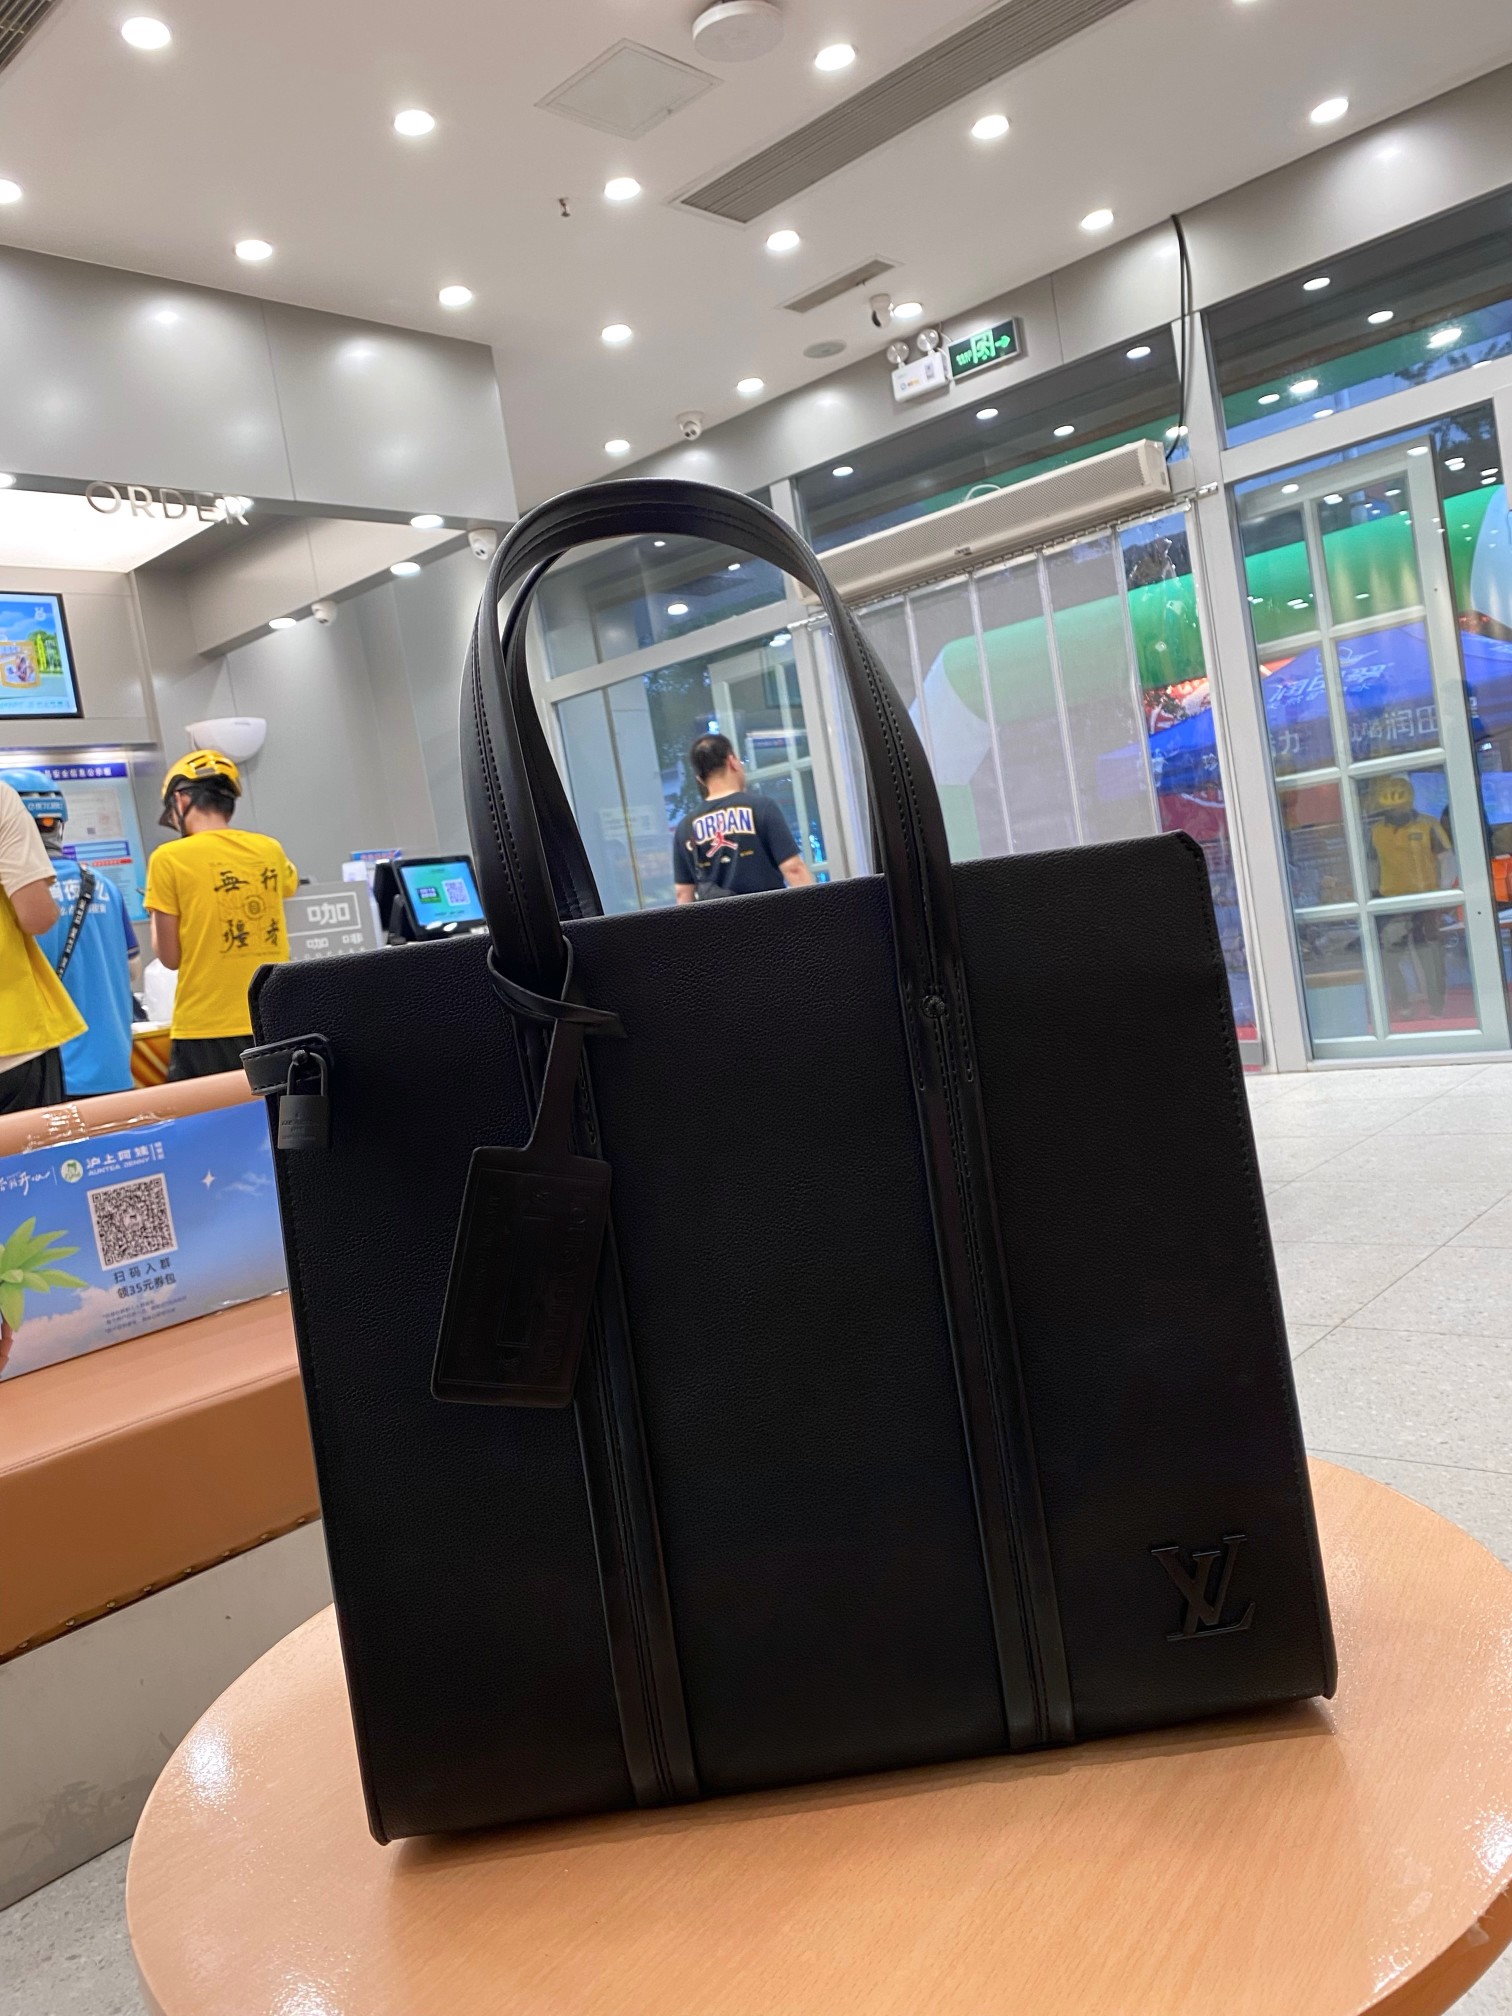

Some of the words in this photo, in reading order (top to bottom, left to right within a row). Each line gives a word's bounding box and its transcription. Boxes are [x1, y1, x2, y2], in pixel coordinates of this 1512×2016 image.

[86, 481, 249, 526] ORDER
[307, 902, 350, 925] 咖
[114, 1257, 171, 1284] 扫码入群
[117, 1273, 177, 1299] 领35元券包
[1151, 1534, 1256, 1641] LV
